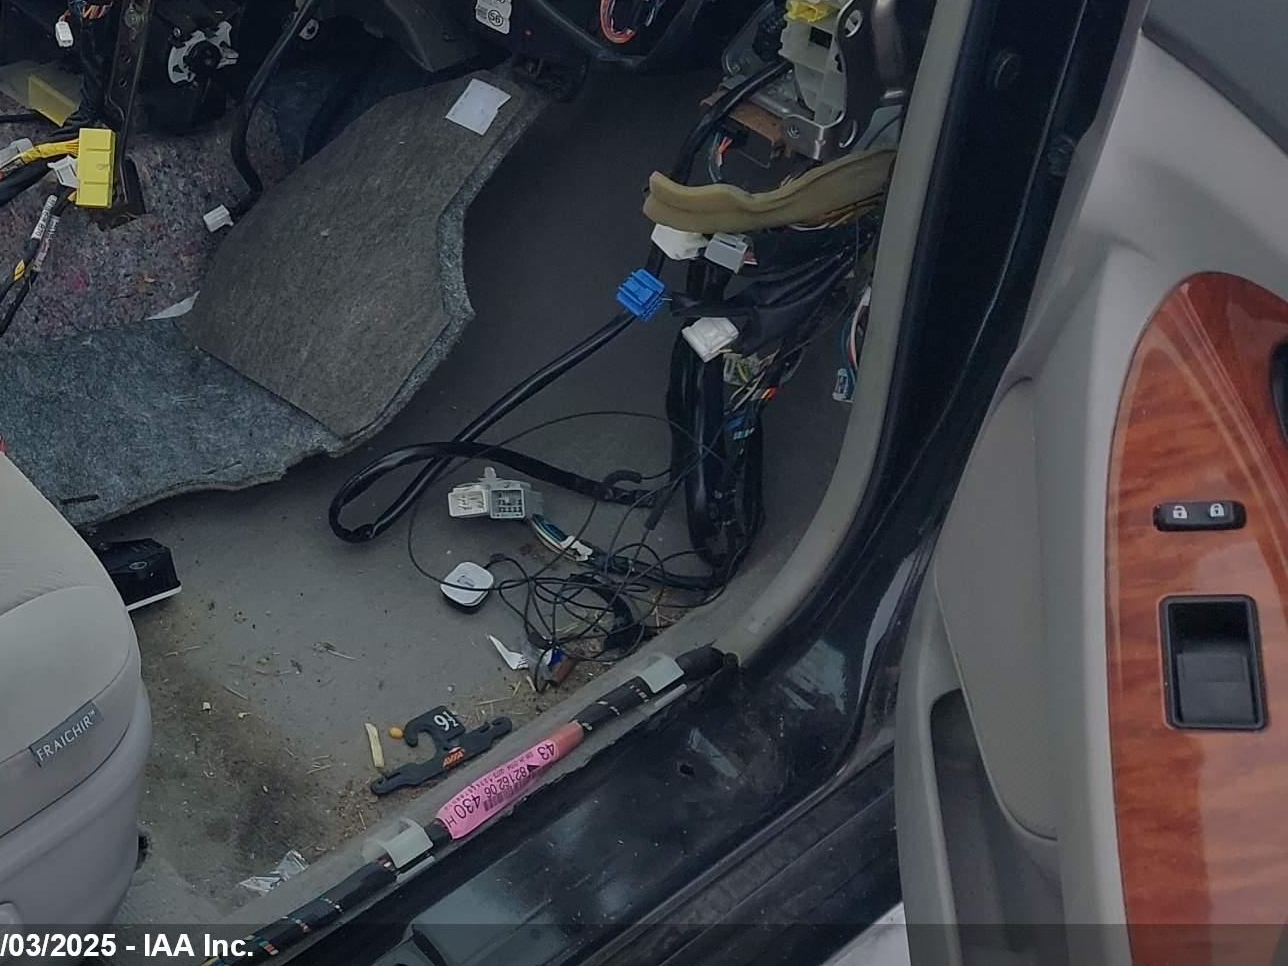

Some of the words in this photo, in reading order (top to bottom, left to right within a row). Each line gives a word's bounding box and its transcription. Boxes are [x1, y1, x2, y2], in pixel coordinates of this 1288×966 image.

[537, 743, 555, 761] 43
[453, 794, 481, 819] 430
[445, 815, 457, 829] H
